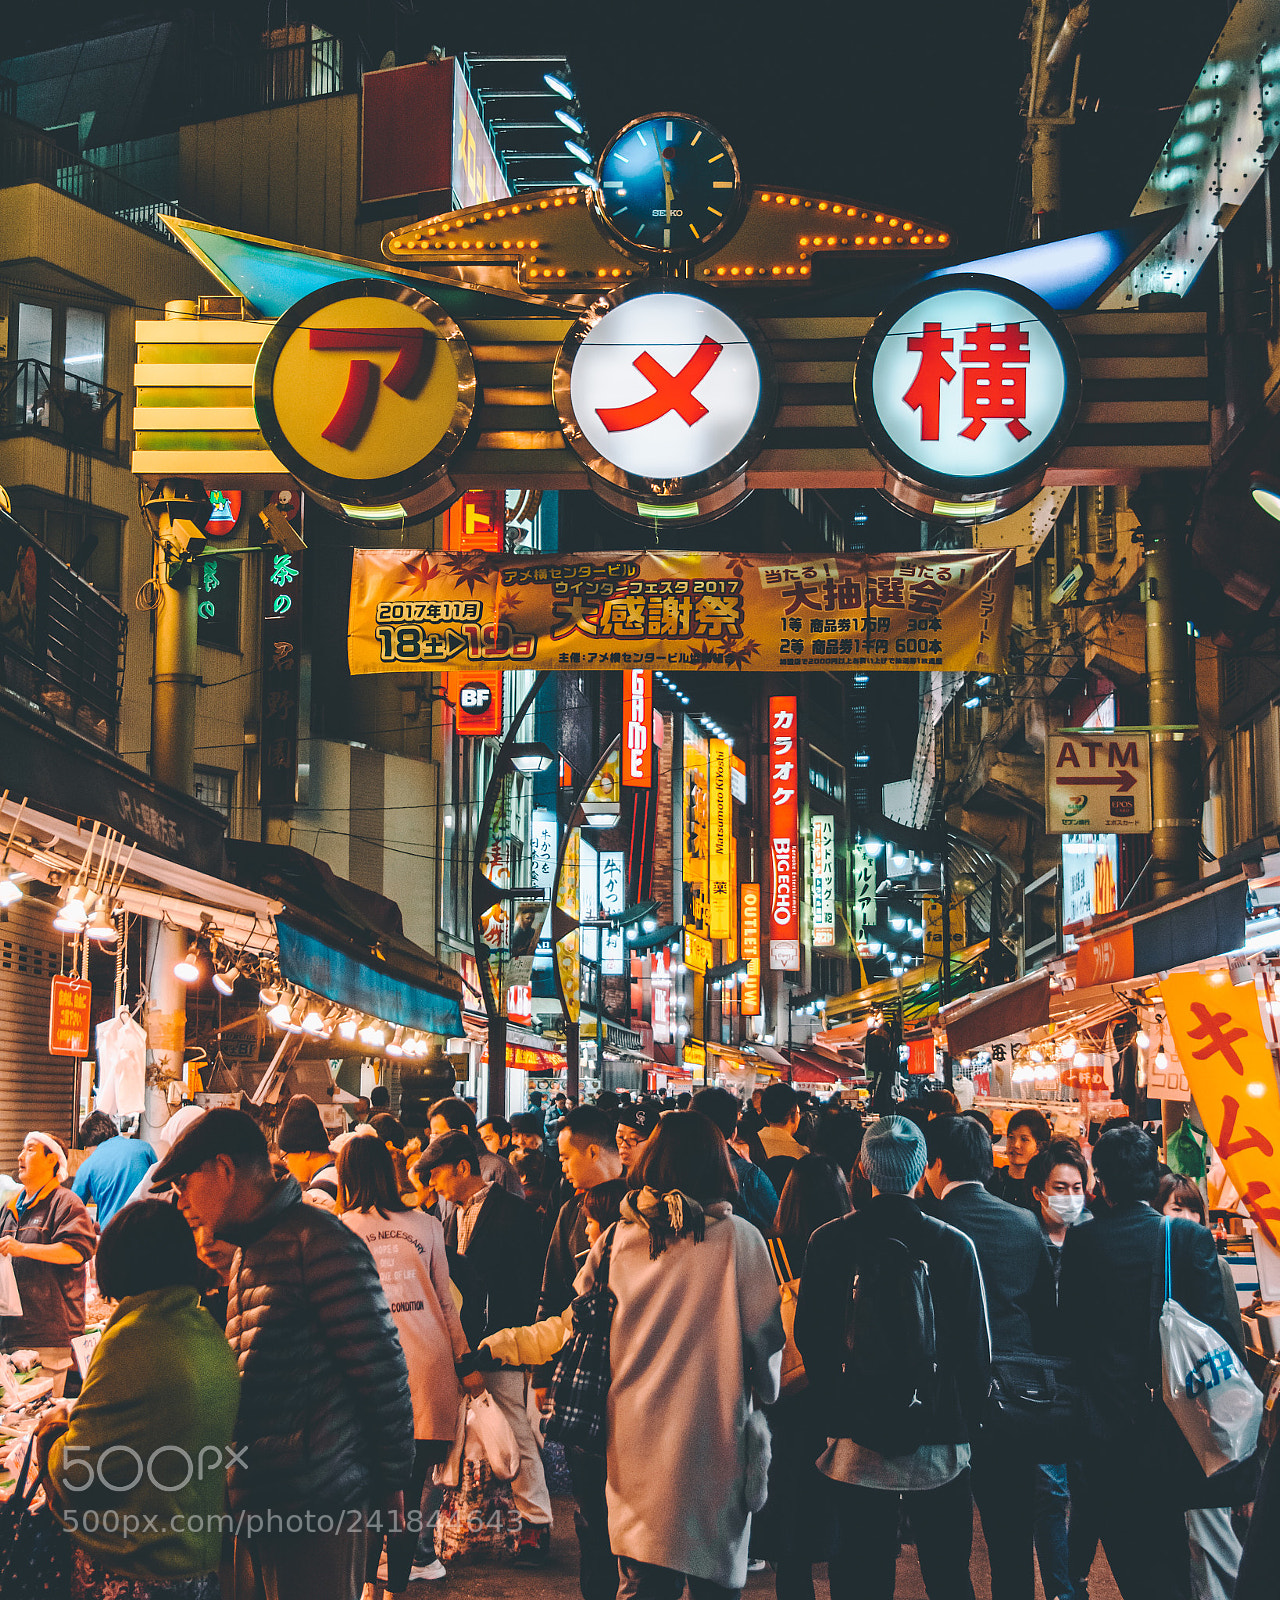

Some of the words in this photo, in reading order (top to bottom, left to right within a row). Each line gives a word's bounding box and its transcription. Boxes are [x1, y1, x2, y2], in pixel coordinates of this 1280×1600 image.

[652, 209, 683, 217] SEKO
[504, 564, 637, 583] アメ横センタービル
[555, 580, 689, 596] ウインターフェスタ
[694, 580, 739, 594] 2017
[781, 576, 947, 616] 大抽選会
[378, 602, 478, 619] 2017年11月
[553, 595, 741, 637] 大感謝祭
[780, 616, 803, 633] 1等
[809, 616, 891, 634] 商品券1万円
[906, 617, 943, 633] 30本
[779, 638, 804, 655] 2等
[895, 638, 943, 655] 600本
[461, 688, 490, 707] BF
[627, 668, 648, 778] GAME
[772, 710, 795, 806] カラオケ
[1056, 742, 1139, 768] ATM
[715, 793, 724, 854] Matsumoto
[772, 838, 791, 872] BIG
[773, 874, 791, 926] ECHO
[744, 893, 757, 954] OUTLET
[926, 931, 964, 942] fae
[365, 1233, 377, 1243] IS
[378, 1229, 426, 1255] NECESSARY
[391, 1300, 424, 1313] CONDITION
